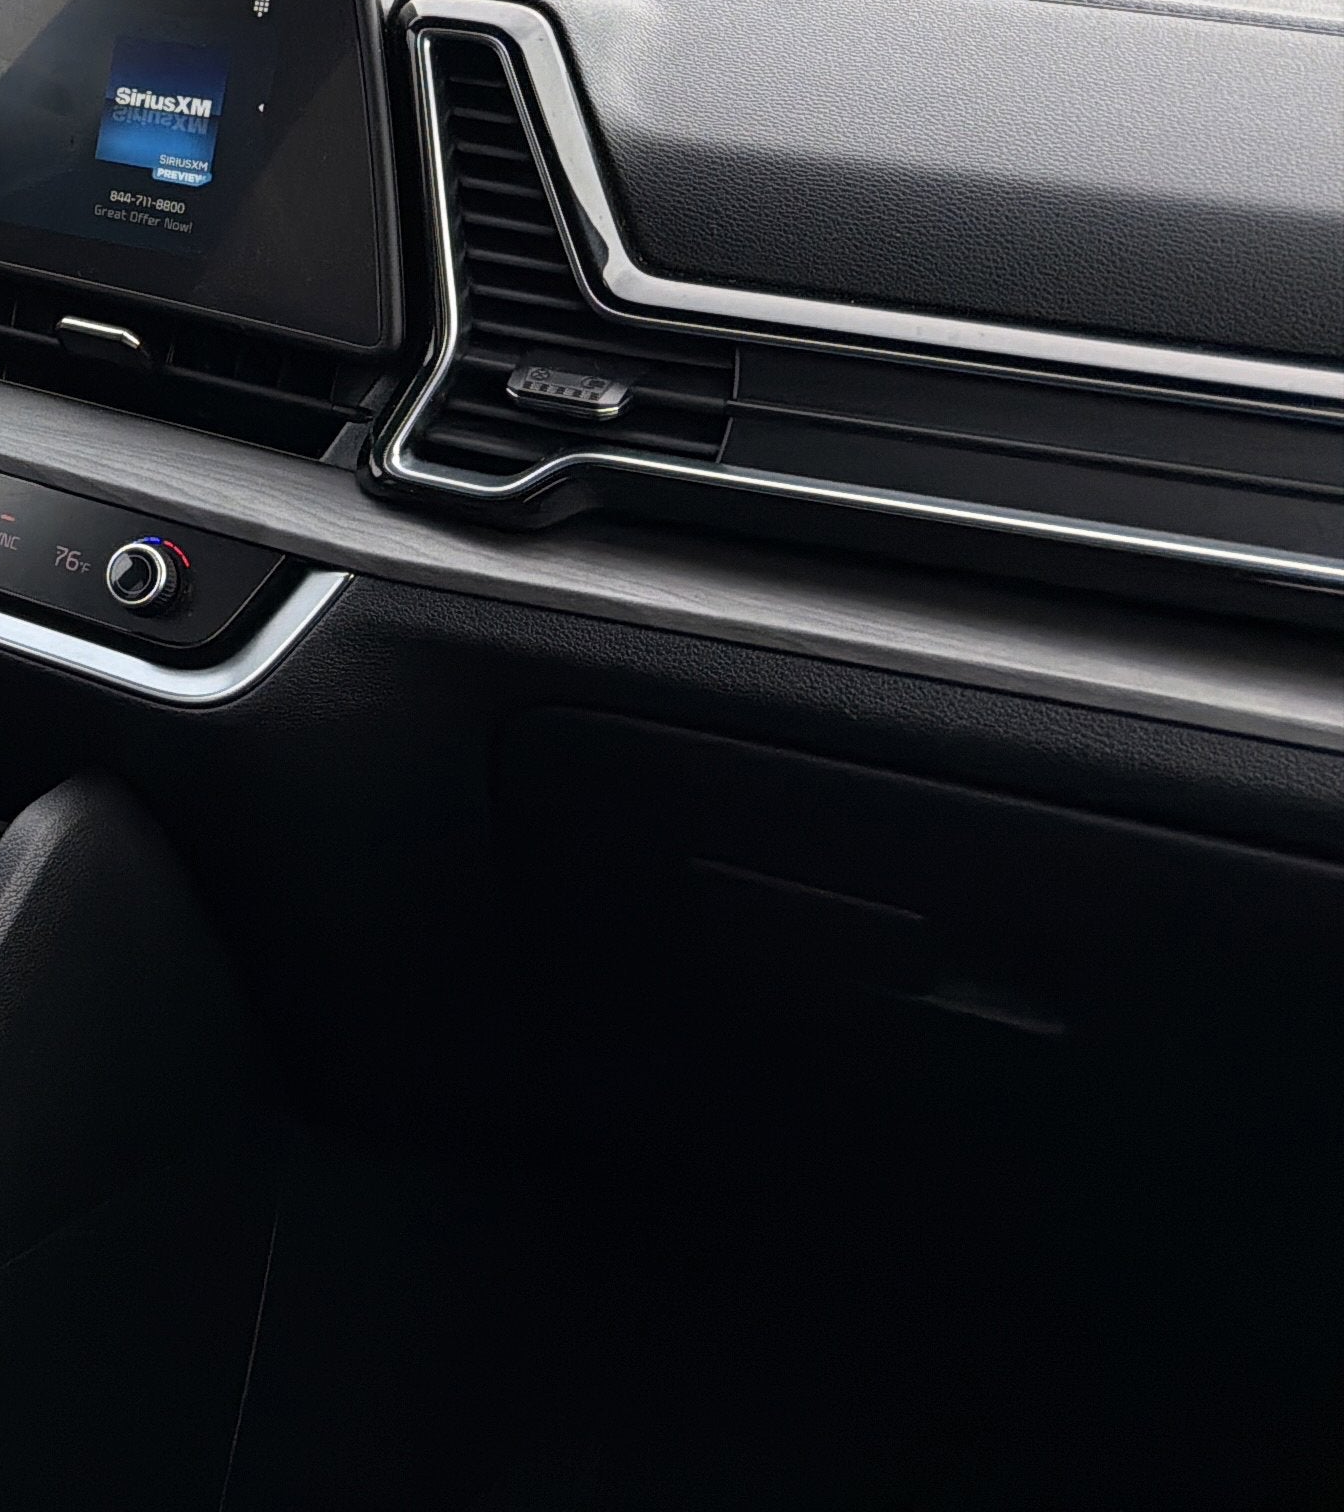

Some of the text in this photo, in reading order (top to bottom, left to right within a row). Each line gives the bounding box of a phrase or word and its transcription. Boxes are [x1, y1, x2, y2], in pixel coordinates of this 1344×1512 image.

[114, 86, 213, 119] SiriusXM
[158, 154, 209, 172] SIRIUSXM
[109, 189, 186, 215] 844-711-8800
[94, 203, 194, 235] Great Offer Now!
